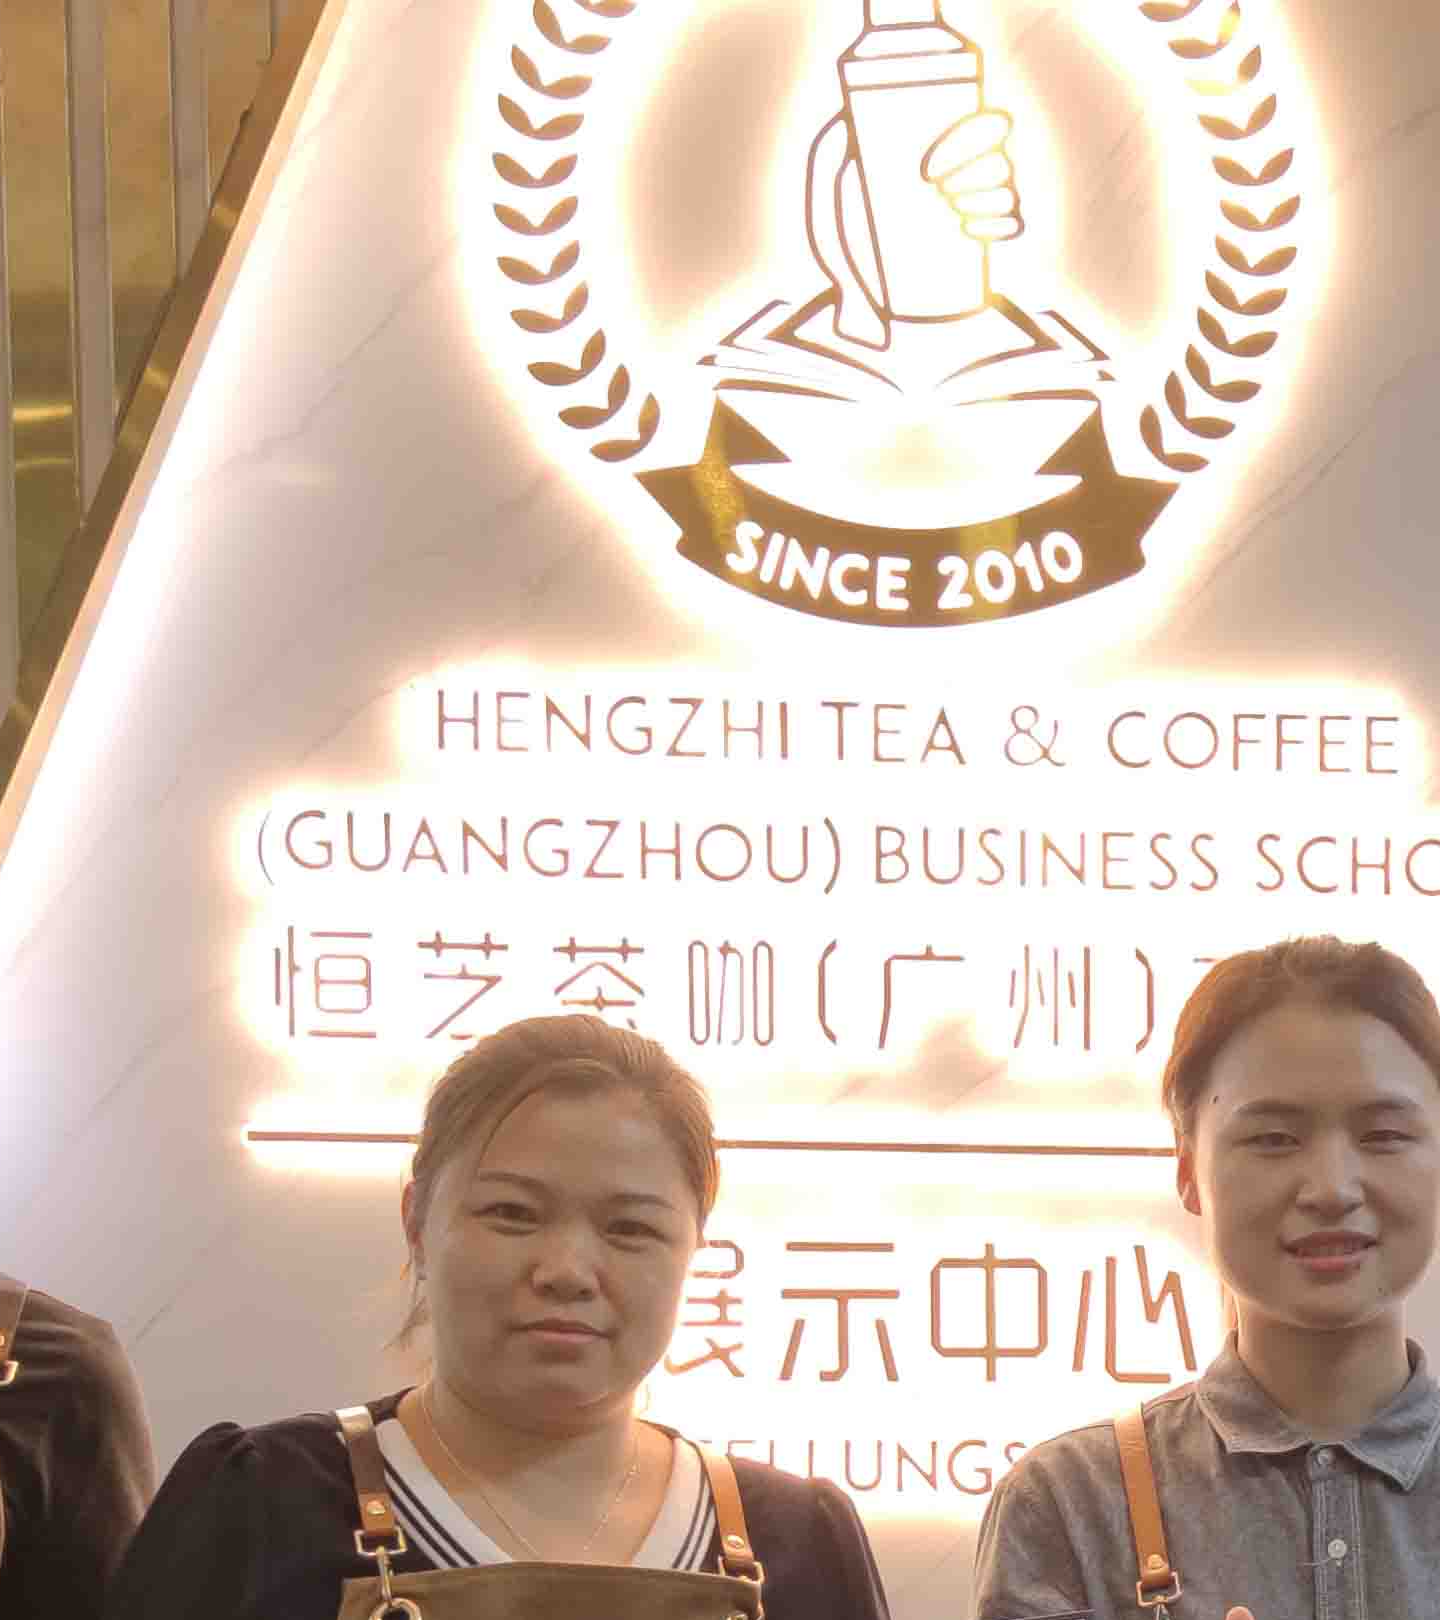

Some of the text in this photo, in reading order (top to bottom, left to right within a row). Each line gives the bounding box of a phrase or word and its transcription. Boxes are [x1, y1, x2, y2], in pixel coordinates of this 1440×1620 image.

[725, 520, 1083, 611] SINCE 2010
[436, 690, 1400, 775] HENGZHI TEA & COFFEE
[257, 809, 841, 895] (GUANGZHOU)
[875, 826, 1219, 891] BUSINESS
[664, 1240, 1198, 1384] 展示中心
